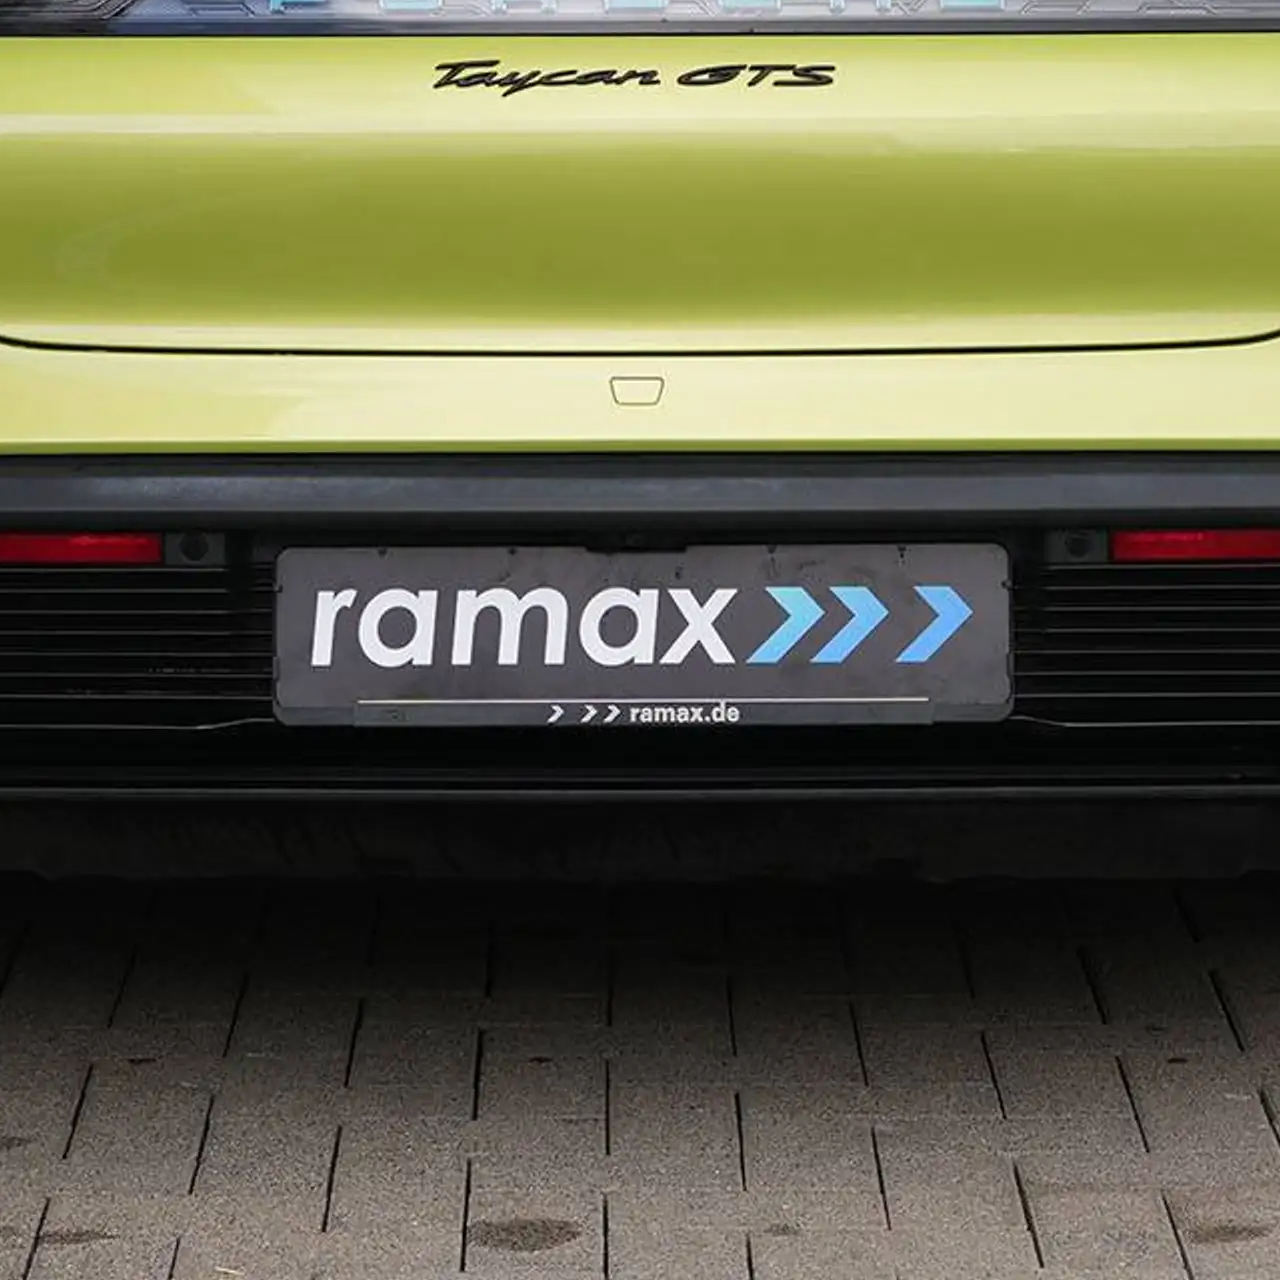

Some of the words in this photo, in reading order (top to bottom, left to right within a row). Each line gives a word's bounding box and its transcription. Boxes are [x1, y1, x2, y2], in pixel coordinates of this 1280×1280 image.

[433, 59, 661, 98] Taycan
[676, 64, 836, 88] GTS
[310, 586, 738, 668] ramax
[629, 703, 740, 724] ramax.de
